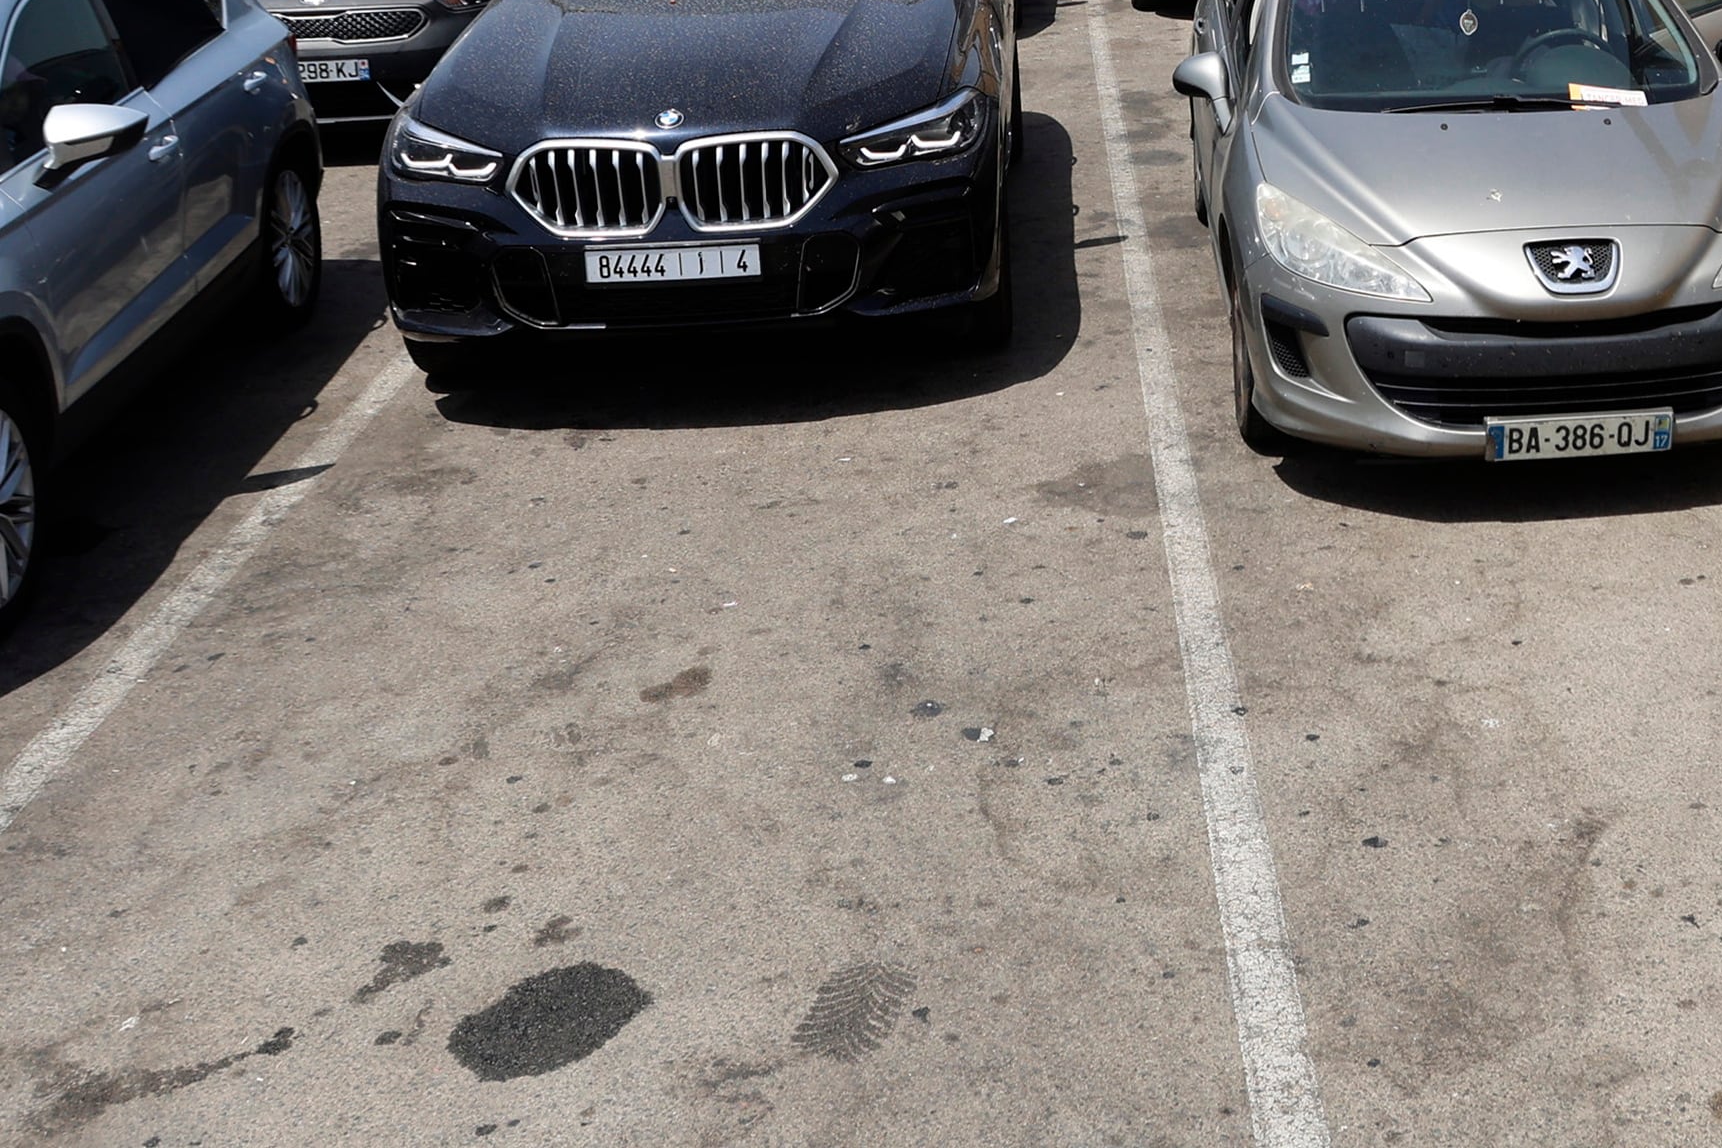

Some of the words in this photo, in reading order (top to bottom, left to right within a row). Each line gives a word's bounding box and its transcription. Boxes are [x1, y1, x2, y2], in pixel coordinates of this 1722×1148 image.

[599, 253, 666, 279] 84444
[736, 249, 748, 272] 4
[1508, 420, 1650, 454] BA-386-QJ
[1655, 435, 1668, 448] 17
